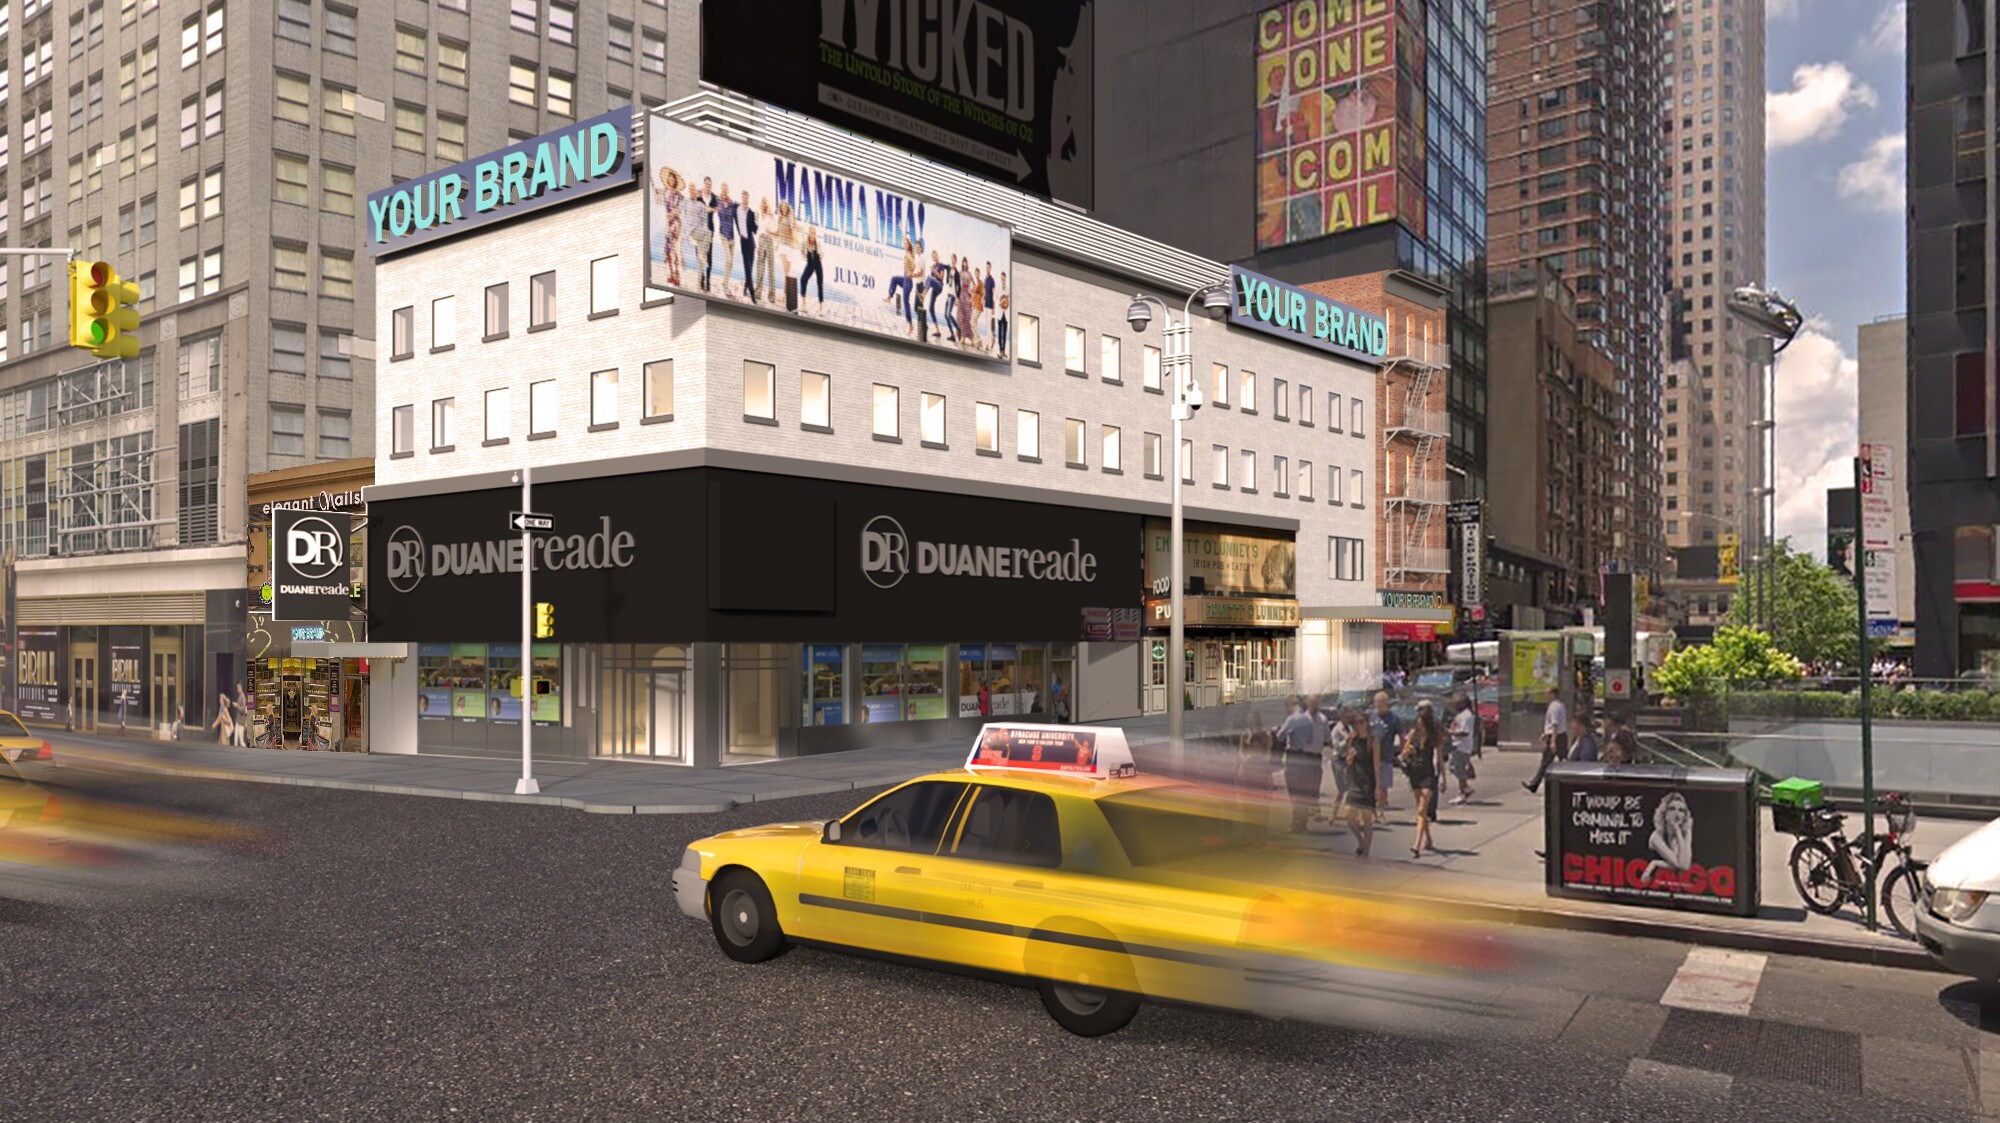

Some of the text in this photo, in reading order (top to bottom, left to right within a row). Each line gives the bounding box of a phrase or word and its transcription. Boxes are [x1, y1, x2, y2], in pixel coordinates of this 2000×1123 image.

[1294, 26, 1385, 88] ONE
[819, 42, 843, 69] THE
[844, 52, 891, 87] UNTOLD
[892, 72, 927, 100] STORY
[928, 87, 941, 108] OF
[941, 93, 962, 114] THE
[963, 100, 1005, 131] WITCHES
[1005, 118, 1018, 136] OF
[847, 101, 890, 122] GERSHWIN
[1294, 129, 1391, 189] COM
[369, 121, 620, 243] YOUR BRAND
[774, 157, 925, 253] MAMMA MIA!
[1329, 184, 1389, 234] AL
[834, 266, 875, 289] JULY 20
[1239, 272, 1387, 357] YOUR BRAND
[263, 490, 360, 514] elegant Nails
[524, 518, 551, 528] ONE WAY
[287, 530, 343, 567] DR
[387, 539, 425, 578] DR
[861, 530, 910, 575] DR
[1155, 536, 1200, 554] EMTT
[1193, 559, 1210, 569] IRISH
[1212, 562, 1224, 571] PUB
[19, 650, 58, 686] BRILL
[112, 659, 141, 682] BRILL
[1010, 730, 1075, 740] SYRACUSE UNIVERSITY
[1572, 792, 1643, 810] IT WOULD BE
[1572, 812, 1644, 828] CRIMINAL TO
[1590, 830, 1632, 846] MISS IT
[1563, 852, 1736, 897] CHICAGO
